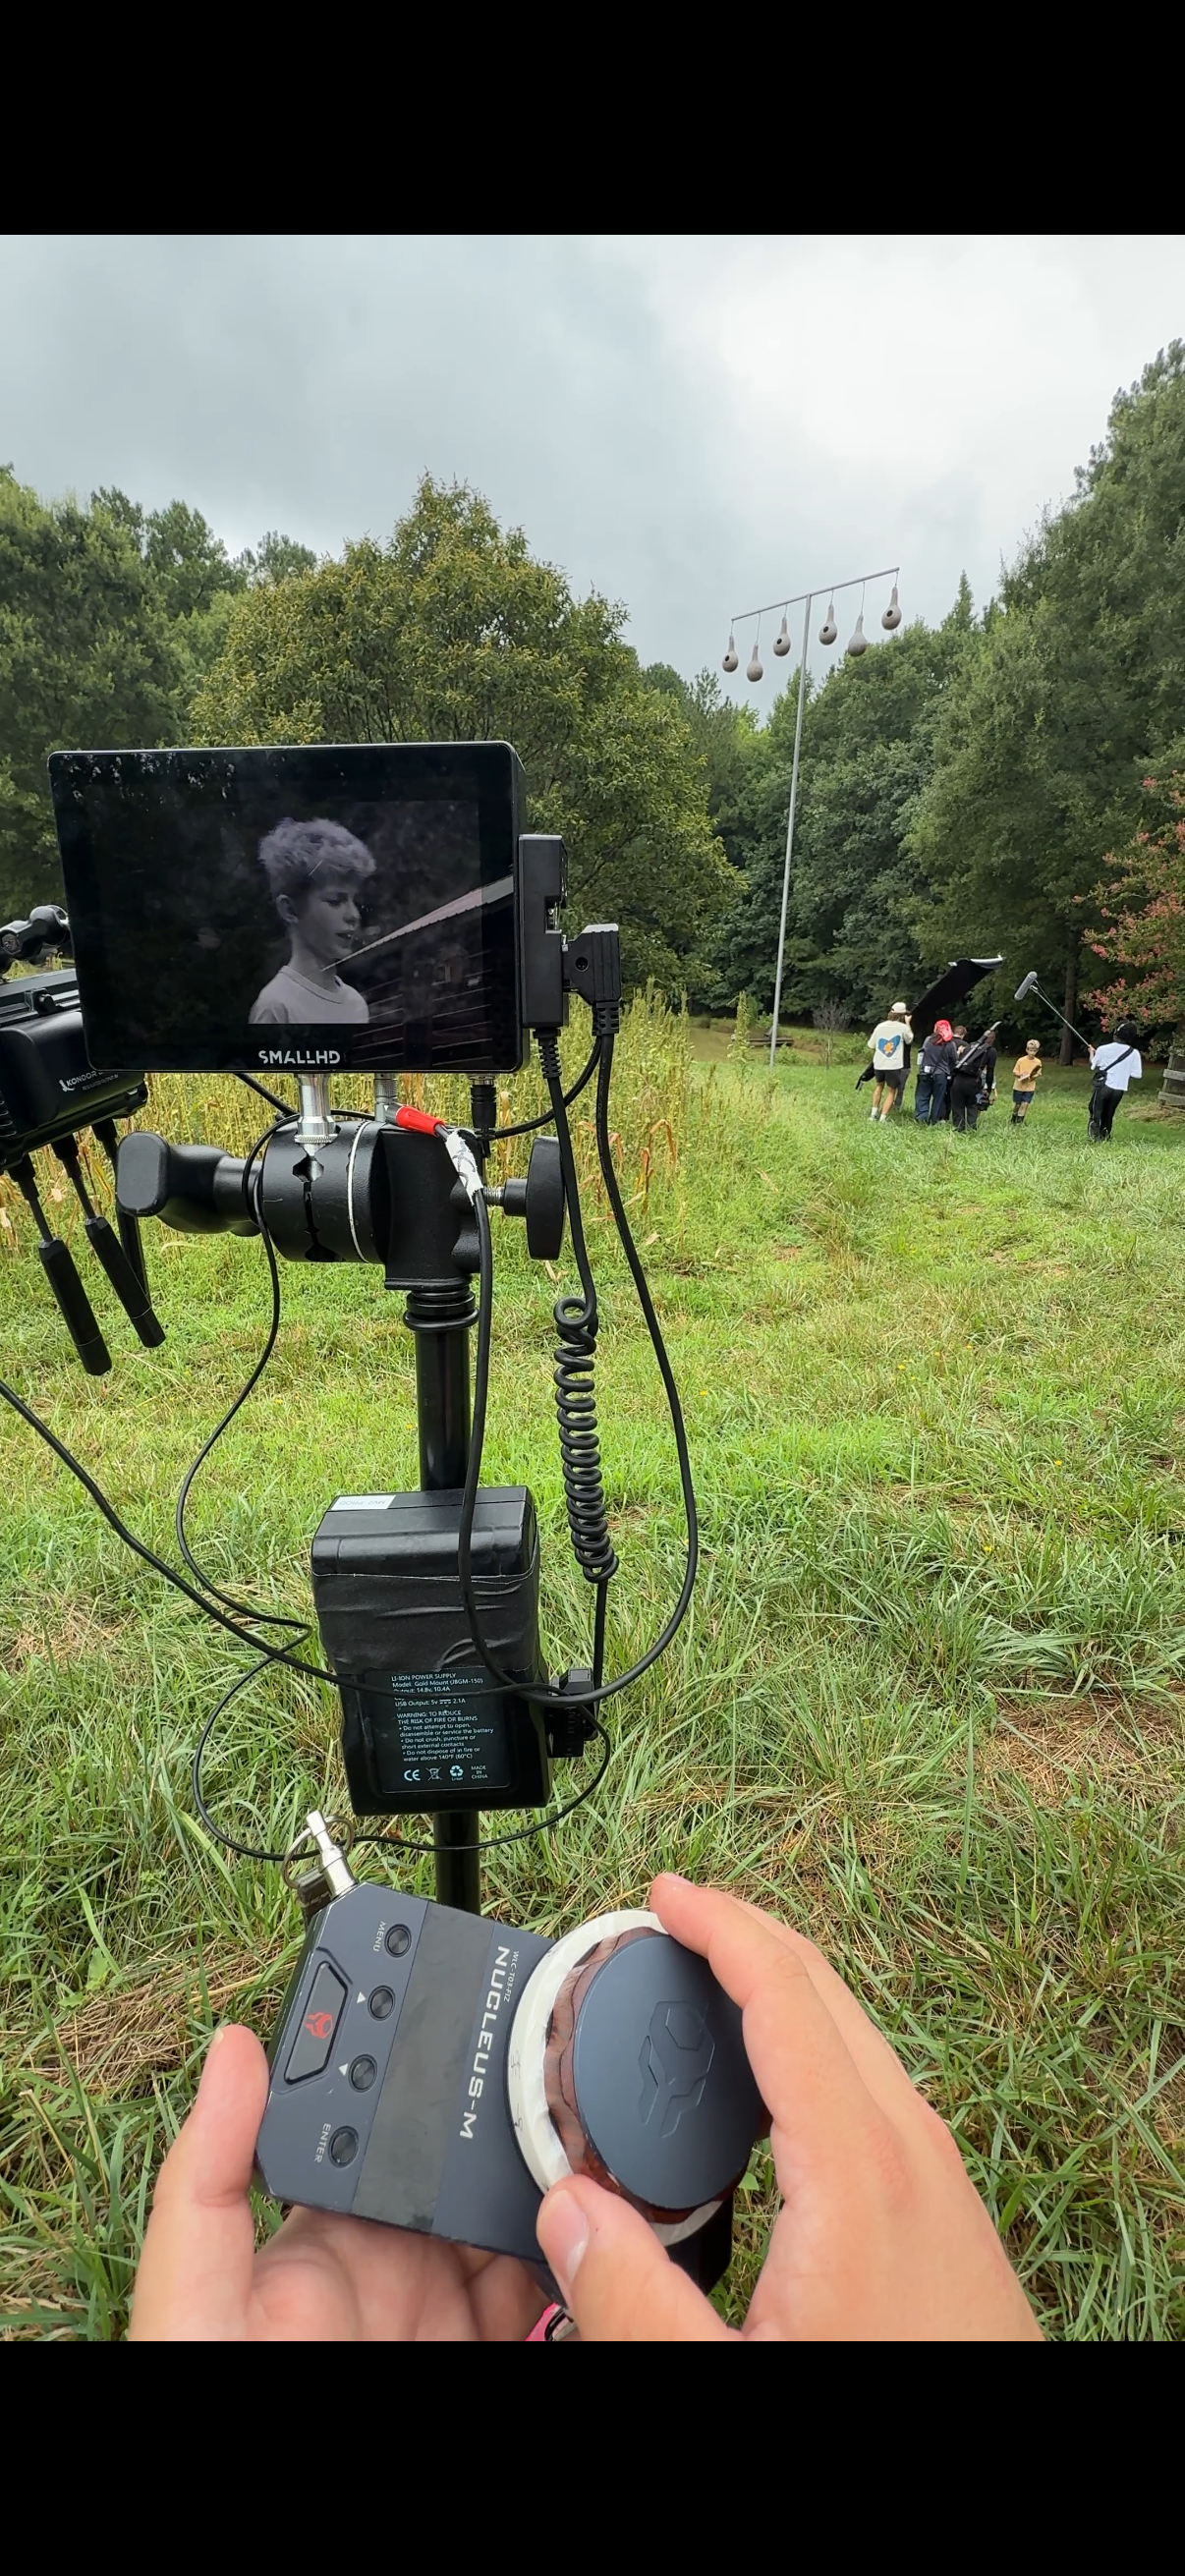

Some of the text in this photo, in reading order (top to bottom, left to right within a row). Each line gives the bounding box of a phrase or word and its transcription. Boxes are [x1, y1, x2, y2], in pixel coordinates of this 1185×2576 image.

[258, 1050, 340, 1064] SMALLHD
[66, 1070, 97, 1087] KONDOR
[404, 1769, 421, 1781] CE
[373, 1921, 386, 1952] MENU
[504, 1951, 519, 2002] WLC-T03-FIZ
[459, 1946, 510, 2139] NUCLEUS-M
[314, 2123, 332, 2163] ENTER
